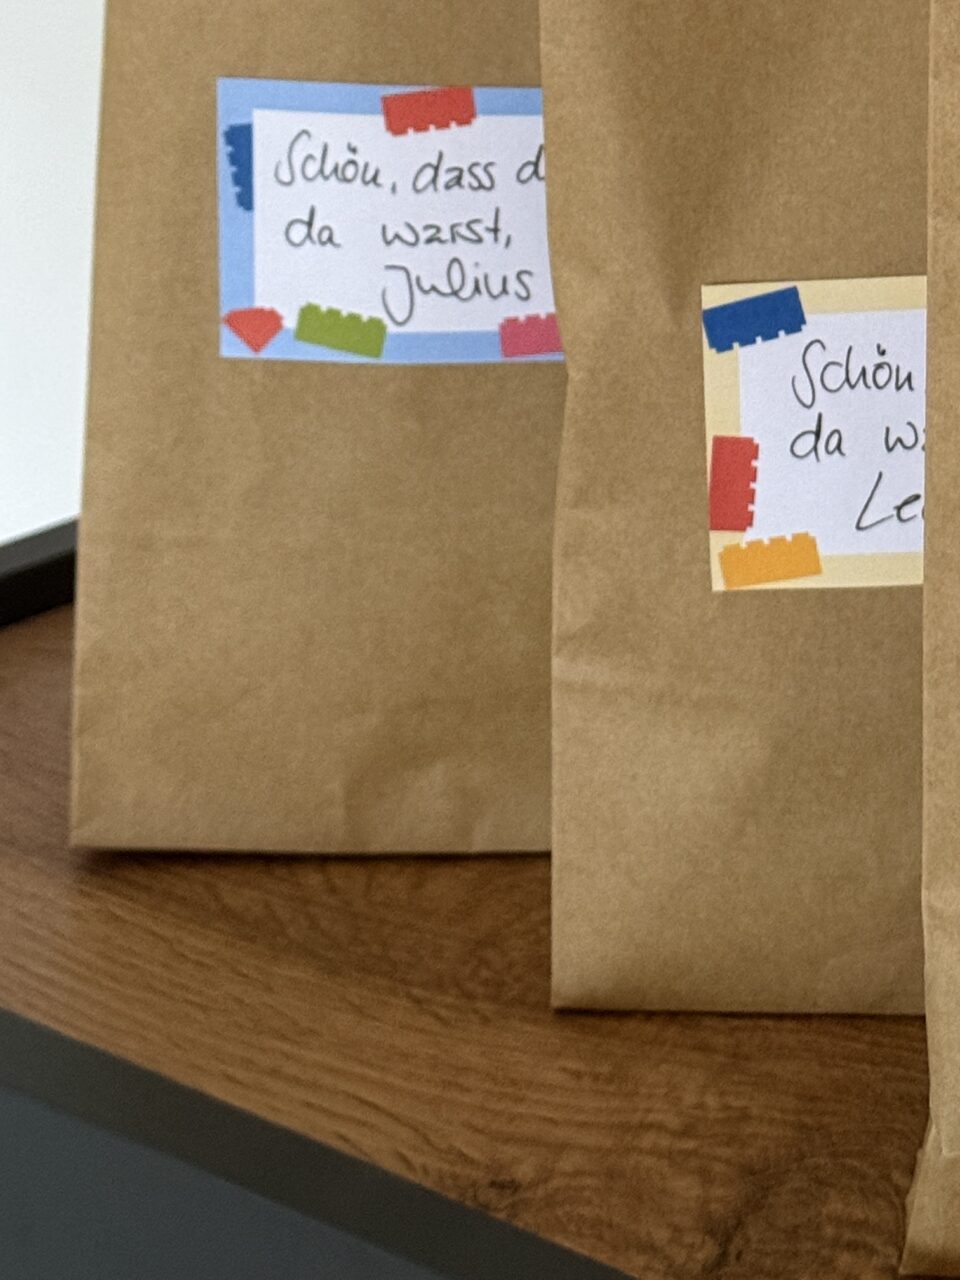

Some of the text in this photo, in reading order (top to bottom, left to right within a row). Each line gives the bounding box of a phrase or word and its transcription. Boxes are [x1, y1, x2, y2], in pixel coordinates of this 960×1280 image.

[274, 128, 546, 196] Schön, dass d
[284, 205, 512, 249] da warst,
[381, 256, 534, 327] Julius
[791, 338, 915, 410] Schön
[789, 411, 927, 463] da w
[854, 470, 925, 532] Le
